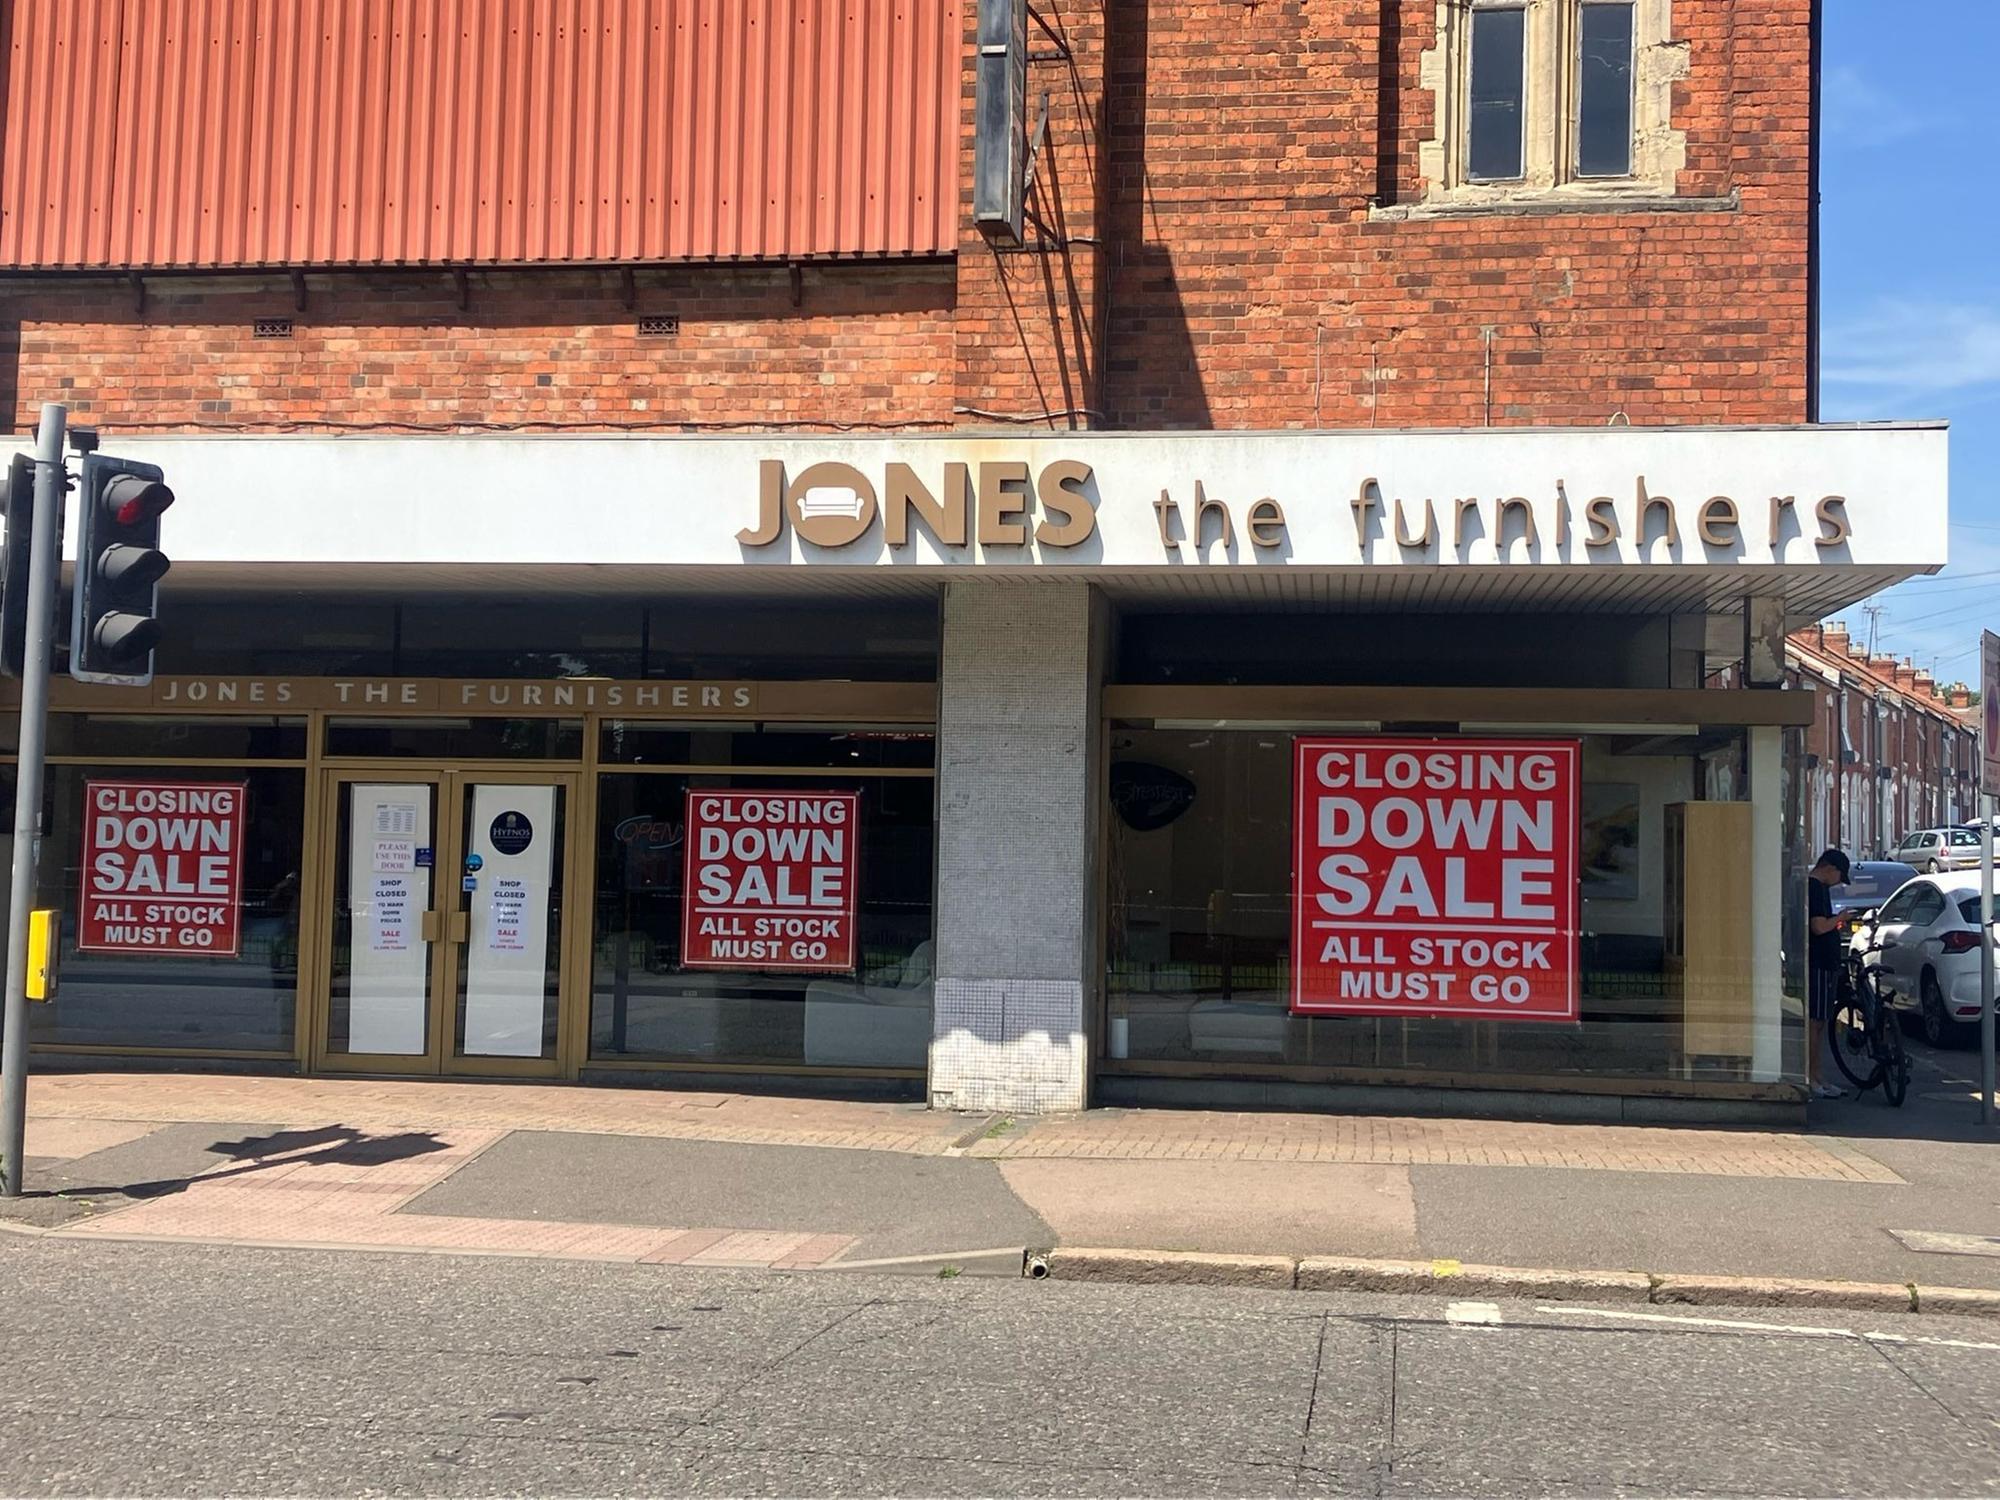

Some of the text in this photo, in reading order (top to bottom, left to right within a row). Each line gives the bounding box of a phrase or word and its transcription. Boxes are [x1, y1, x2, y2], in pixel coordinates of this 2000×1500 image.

[735, 459, 1846, 548] JONES the furnishers
[162, 681, 751, 708] JONES THE FURNISHERS
[1316, 752, 1556, 791] CLOSING
[96, 789, 233, 815] CLOSING
[700, 799, 845, 824] CLOSING
[95, 816, 231, 852] DOWN
[620, 822, 680, 842] OPEN
[1318, 797, 1553, 851] DOWN
[375, 852, 412, 861] USE THIS
[378, 843, 409, 851] PLEASE
[700, 827, 843, 863] DOWN
[93, 852, 230, 894] SALE
[381, 861, 405, 870] DOOR
[375, 890, 407, 898] CLOSED
[380, 879, 402, 887] SHOP
[494, 890, 526, 899] CLOSED
[500, 880, 522, 888] SHOP
[698, 864, 843, 906] SALE
[1316, 854, 1555, 920] SALE
[94, 903, 225, 924] ALL STOCK
[104, 926, 213, 945] MUST GO
[497, 929, 518, 937] SALE
[699, 917, 840, 938] ALL STOCK
[712, 940, 827, 960] MUST GO
[1320, 936, 1551, 969] ALL STOCK
[1340, 971, 1530, 1003] MUST GO
